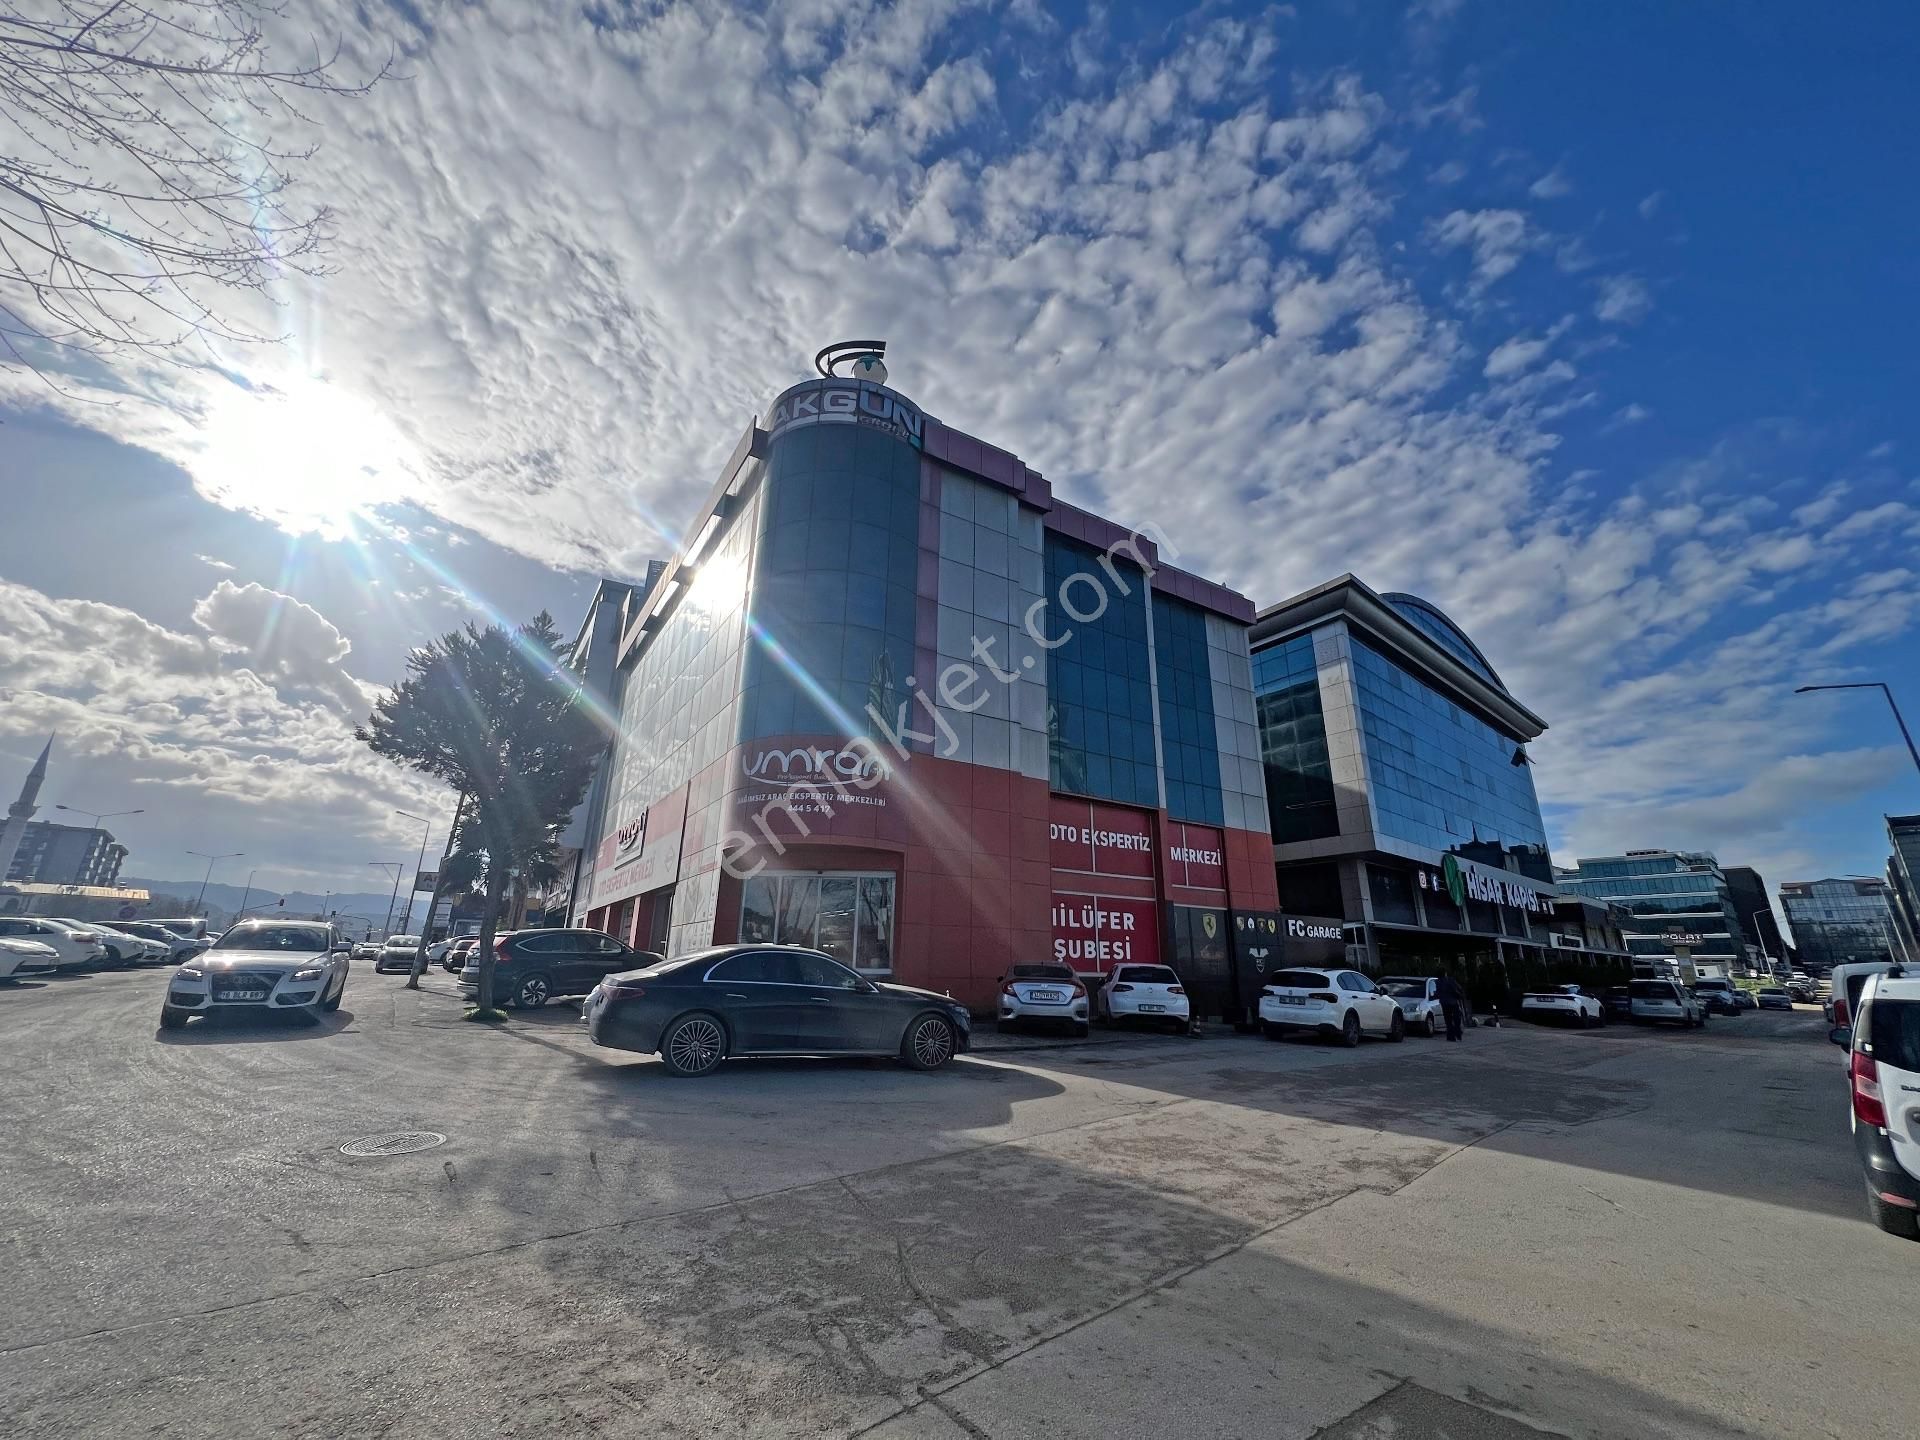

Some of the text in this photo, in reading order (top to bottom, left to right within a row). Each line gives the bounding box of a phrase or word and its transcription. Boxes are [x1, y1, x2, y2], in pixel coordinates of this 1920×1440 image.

[806, 804, 812, 812] 5
[1050, 824, 1151, 852] OTO EKSPERTİZ
[1170, 846, 1222, 866] MERKEZİ
[1287, 919, 1342, 940] FC GARAGE
[1054, 936, 1131, 962] ŞUBESİ
